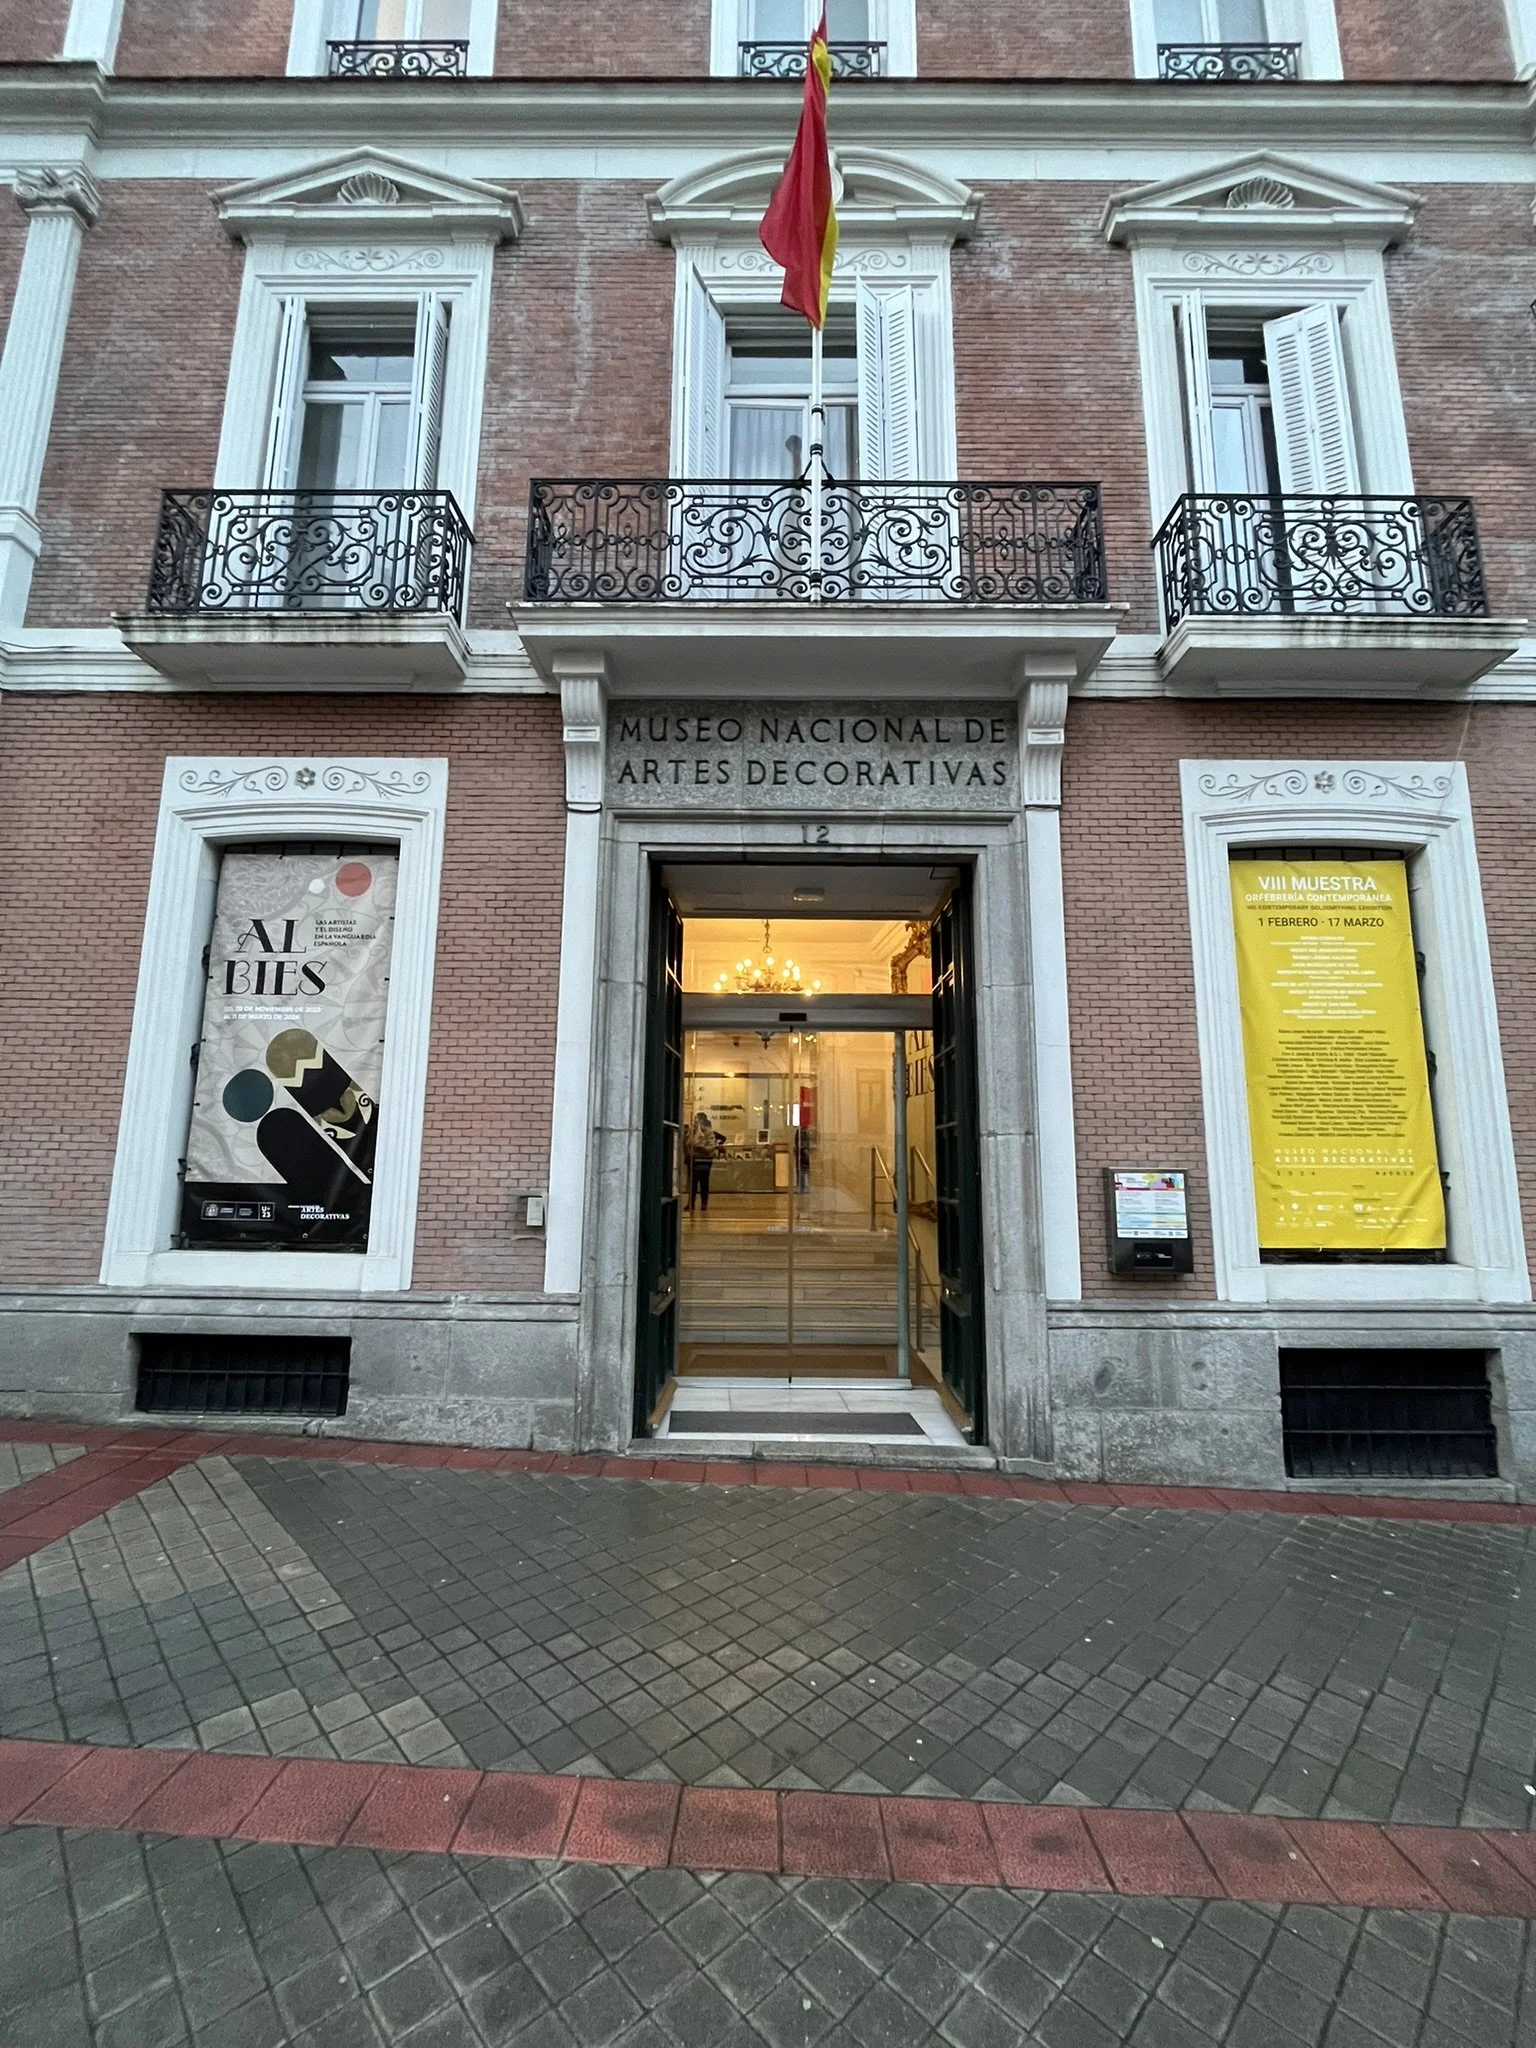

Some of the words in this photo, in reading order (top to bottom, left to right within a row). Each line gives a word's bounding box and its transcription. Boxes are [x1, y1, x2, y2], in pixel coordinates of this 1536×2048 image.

[619, 717, 744, 743] MUSEO
[759, 717, 952, 744] NACIONAL
[964, 718, 1006, 744] DE
[617, 759, 731, 785] ARTES
[746, 760, 1007, 786] DECORATIVAS
[801, 825, 830, 844] 12
[1258, 876, 1286, 891] VIII
[1291, 876, 1377, 891] MUESTRA
[234, 918, 307, 954] AL
[1258, 918, 1264, 926] 1
[1268, 918, 1318, 926] FEBRERO
[1328, 918, 1341, 926] 17
[1344, 918, 1385, 927] MARZO
[222, 960, 328, 996] BIES
